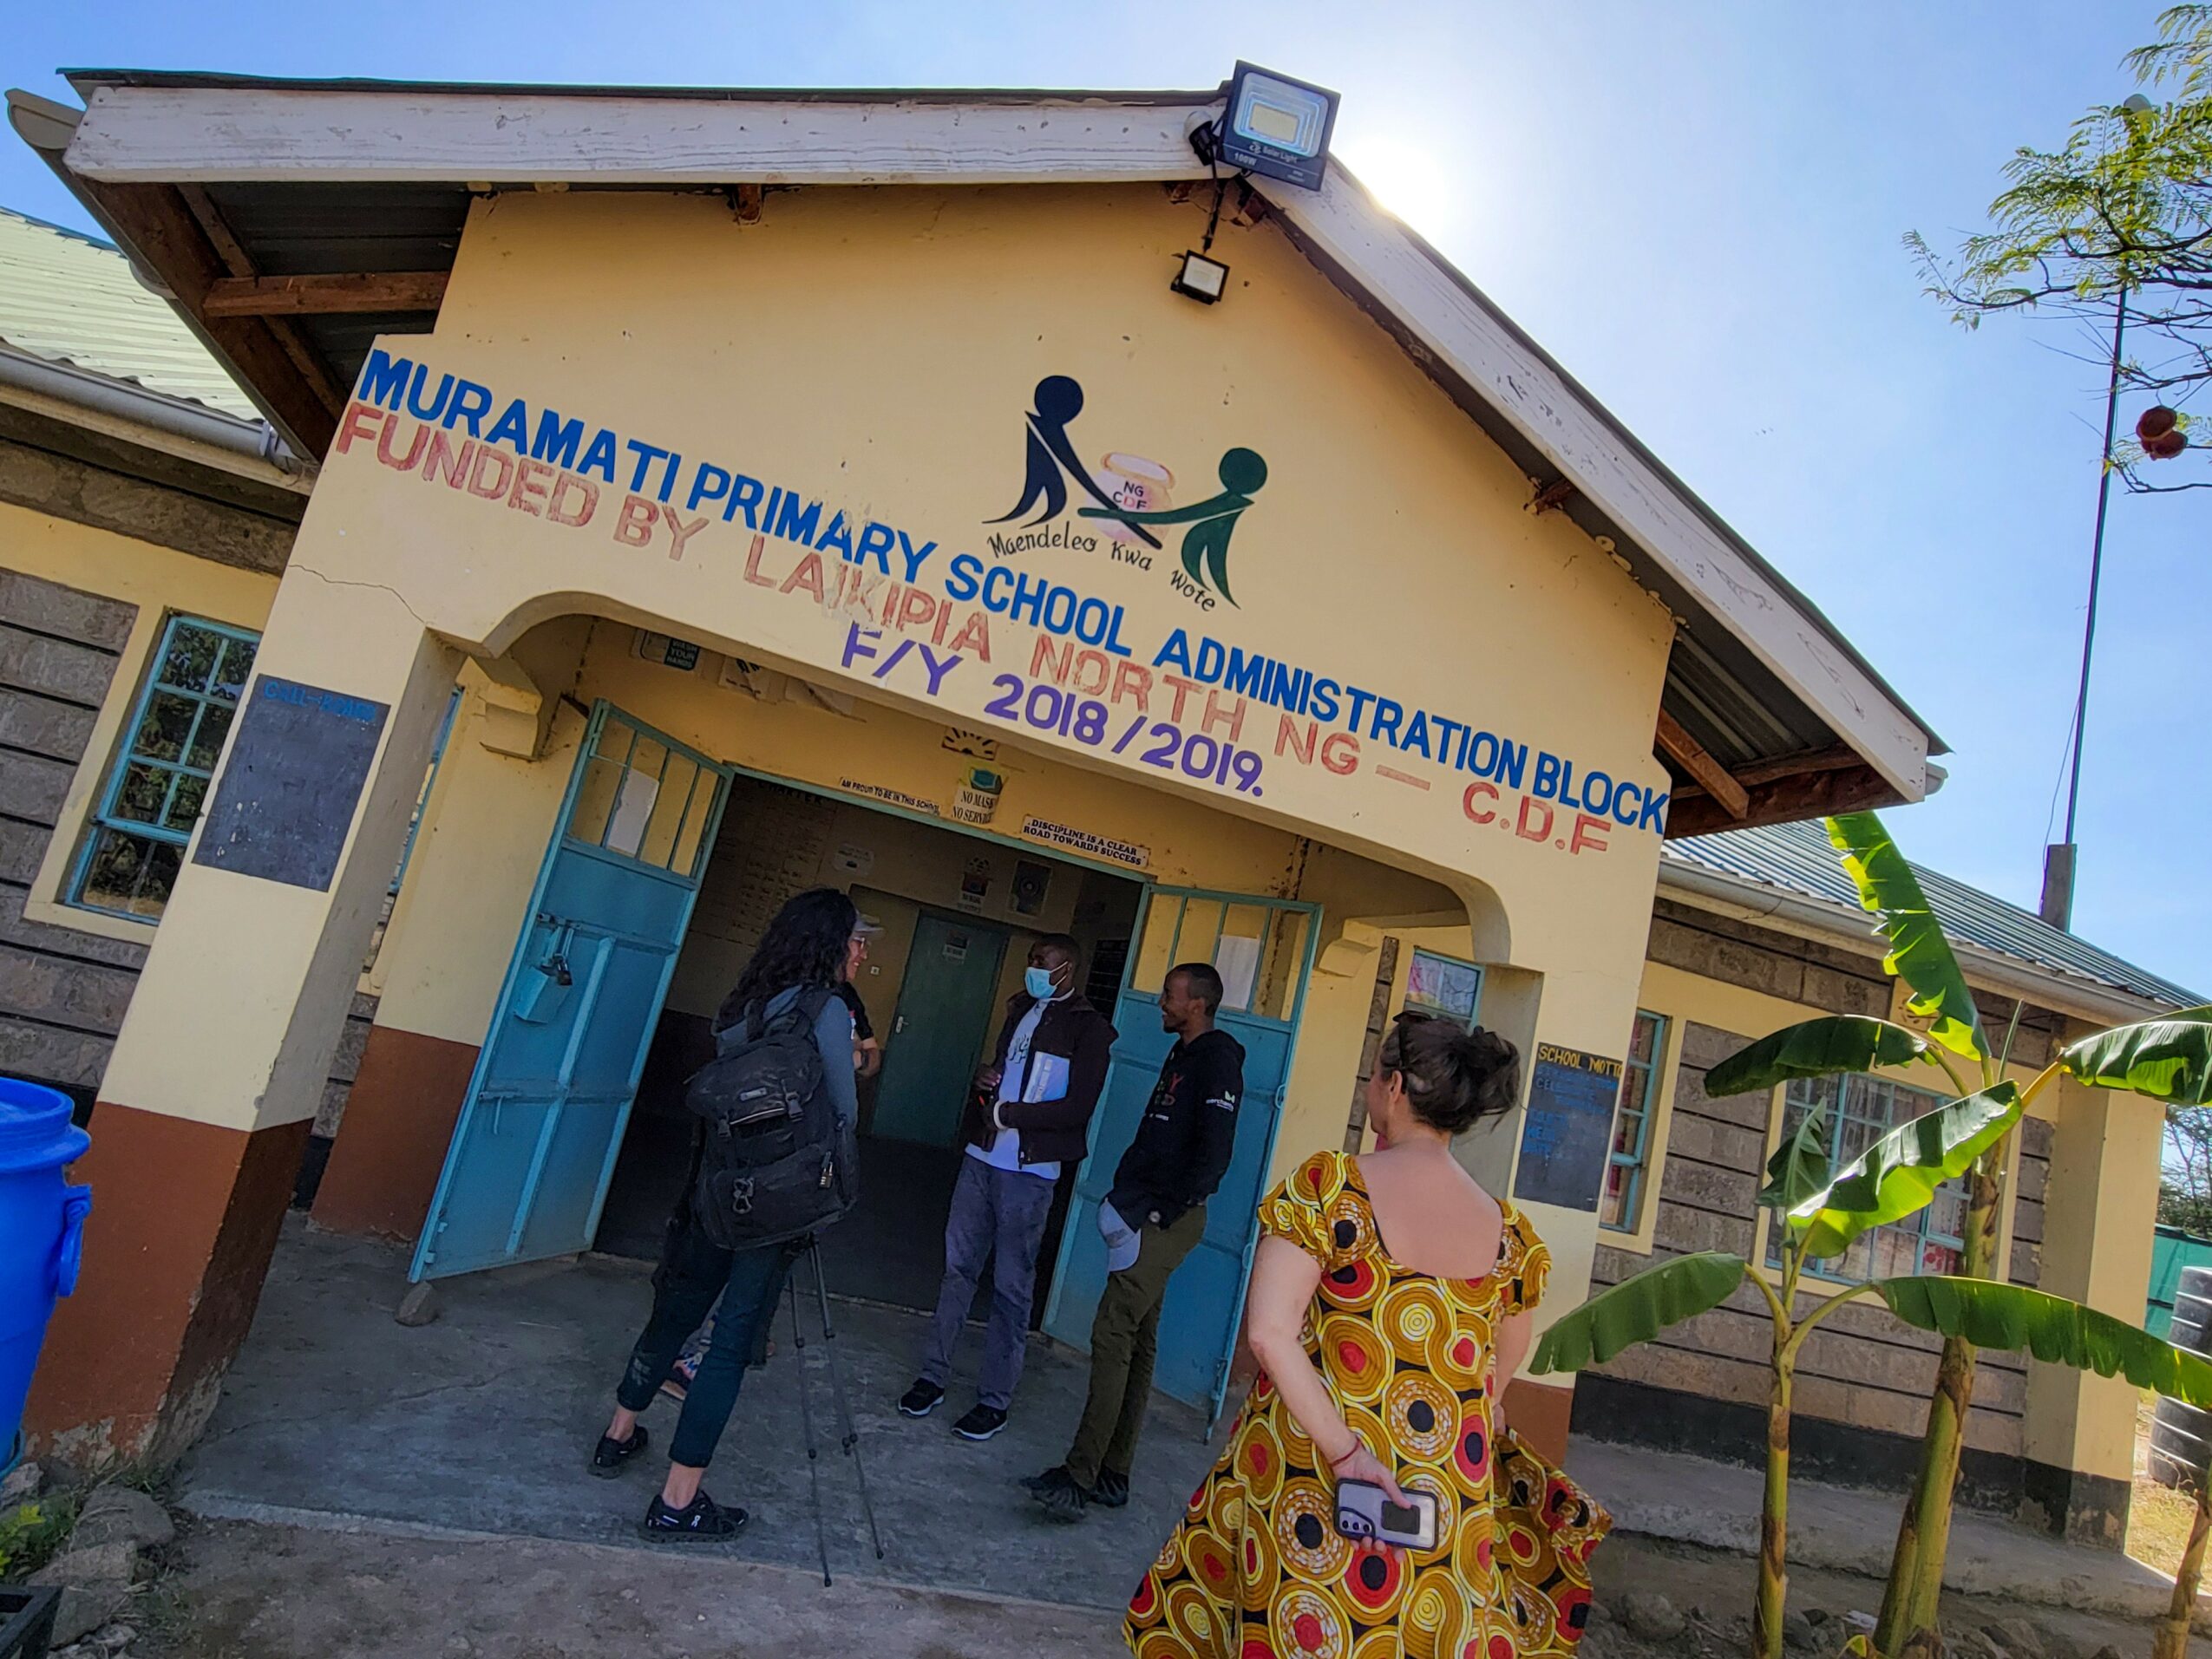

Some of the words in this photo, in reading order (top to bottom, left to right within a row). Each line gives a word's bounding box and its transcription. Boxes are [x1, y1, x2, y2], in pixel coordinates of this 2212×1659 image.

[1234, 153, 1257, 167] 100W
[1123, 481, 1143, 497] NG
[1113, 492, 1147, 510] CDF
[987, 520, 1097, 558] Maendeleo
[1111, 540, 1152, 572] Kwa
[1171, 569, 1215, 611] Wote
[357, 349, 682, 503] MURAMATI
[686, 462, 938, 585] PRIMARY
[945, 553, 1132, 658] SCHOOL
[1152, 628, 1528, 791] ADMINISTRATION
[1532, 750, 1671, 835] BLOCK
[336, 402, 600, 527] FUNDED
[612, 494, 710, 562] BY
[743, 533, 991, 663] LAIKIPIA
[1029, 634, 1247, 743] NORTH
[1273, 714, 1361, 776] NG
[1463, 782, 1612, 856] C.D.F
[841, 619, 964, 696] F/Y
[874, 786, 883, 797] TO
[884, 790, 892, 800] BE
[901, 794, 915, 807] THIS
[961, 790, 973, 804] NO
[952, 805, 964, 820] NO
[1024, 826, 1051, 839] ROAD
[1052, 833, 1099, 853] TOWARDS
[1100, 847, 1142, 865] SUCCESS
[1032, 819, 1085, 840] DISCIPLINE
[1087, 834, 1096, 843] IS
[1107, 840, 1136, 856] CLEAR
[1539, 1046, 1581, 1069] SCHOOL
